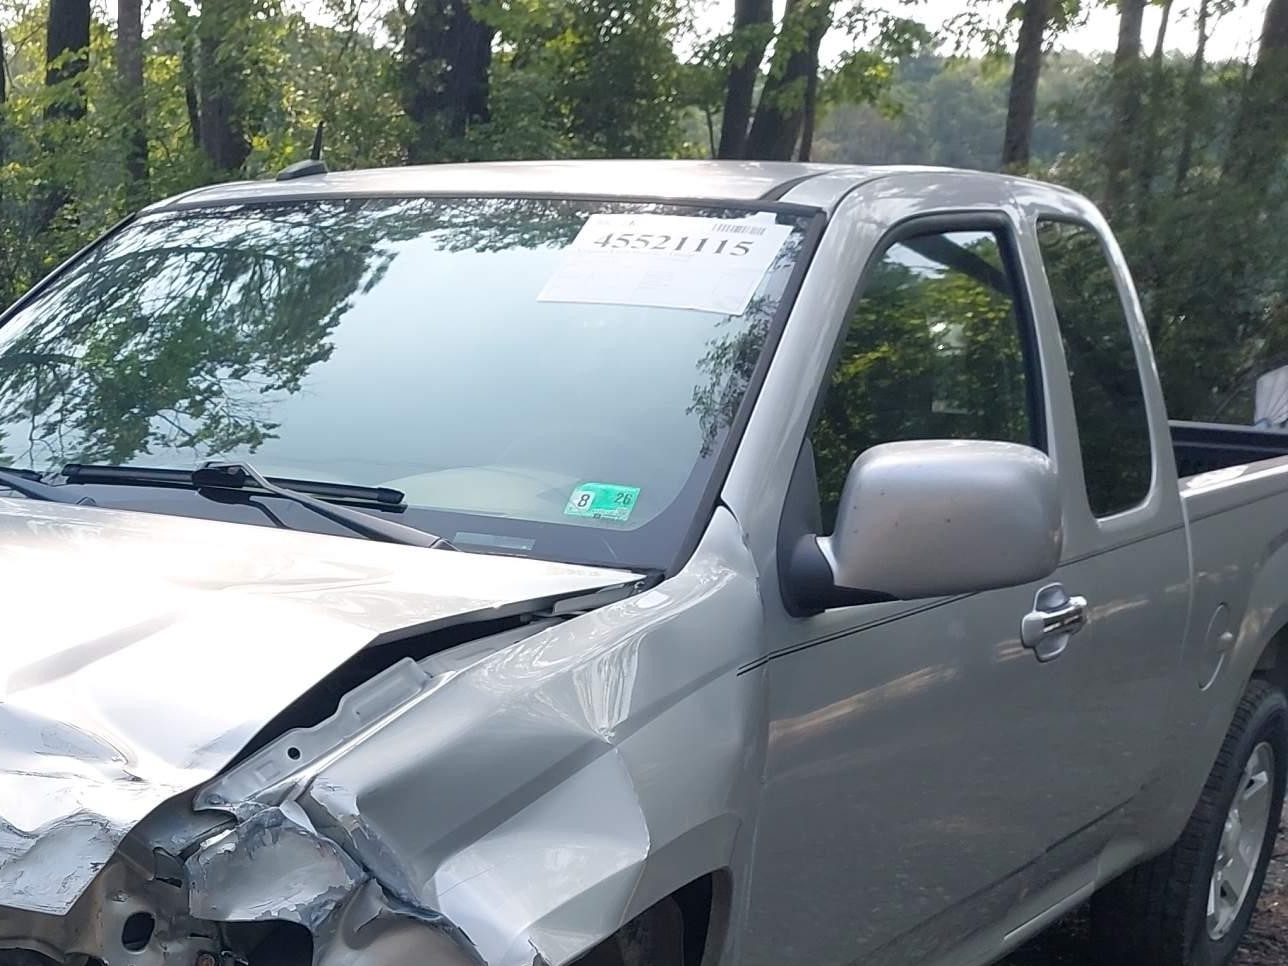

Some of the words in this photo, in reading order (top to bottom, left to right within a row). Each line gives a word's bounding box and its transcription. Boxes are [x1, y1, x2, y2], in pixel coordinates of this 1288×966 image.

[594, 232, 754, 257] 45521115
[577, 493, 591, 507] 8
[614, 492, 633, 505] 26
